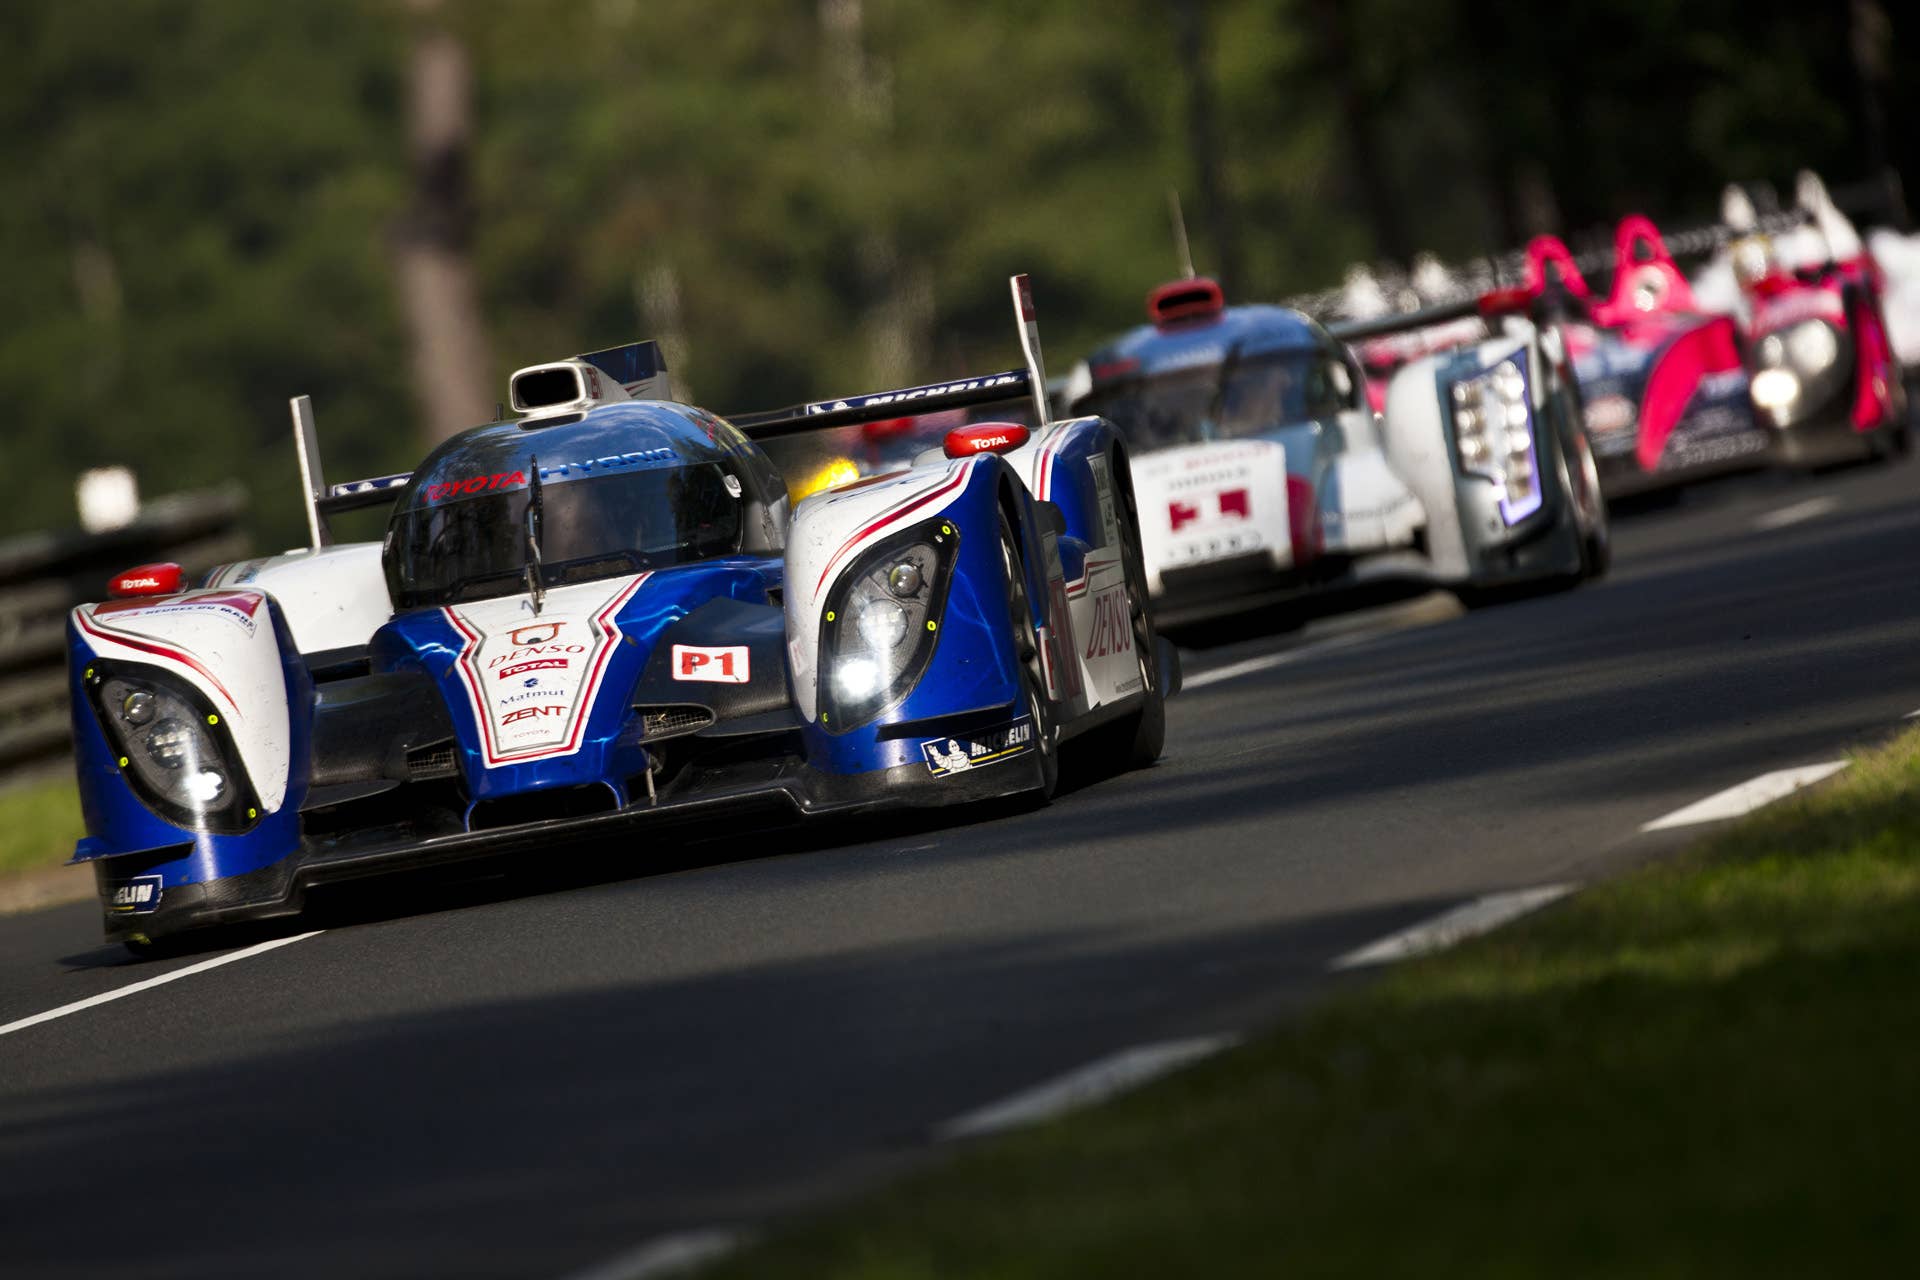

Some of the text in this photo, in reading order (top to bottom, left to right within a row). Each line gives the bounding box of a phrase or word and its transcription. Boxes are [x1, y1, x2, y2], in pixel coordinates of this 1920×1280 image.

[971, 435, 1009, 449] TOTAL
[423, 471, 527, 502] TOYOTA
[540, 447, 679, 480] HYBRID
[121, 578, 159, 589] TOTAL
[1086, 589, 1130, 660] DENSO
[488, 645, 585, 669] DENSO
[682, 652, 734, 676] P1
[502, 661, 567, 677] TOTAL
[500, 689, 565, 707] Matmut
[502, 706, 567, 726] ZENT
